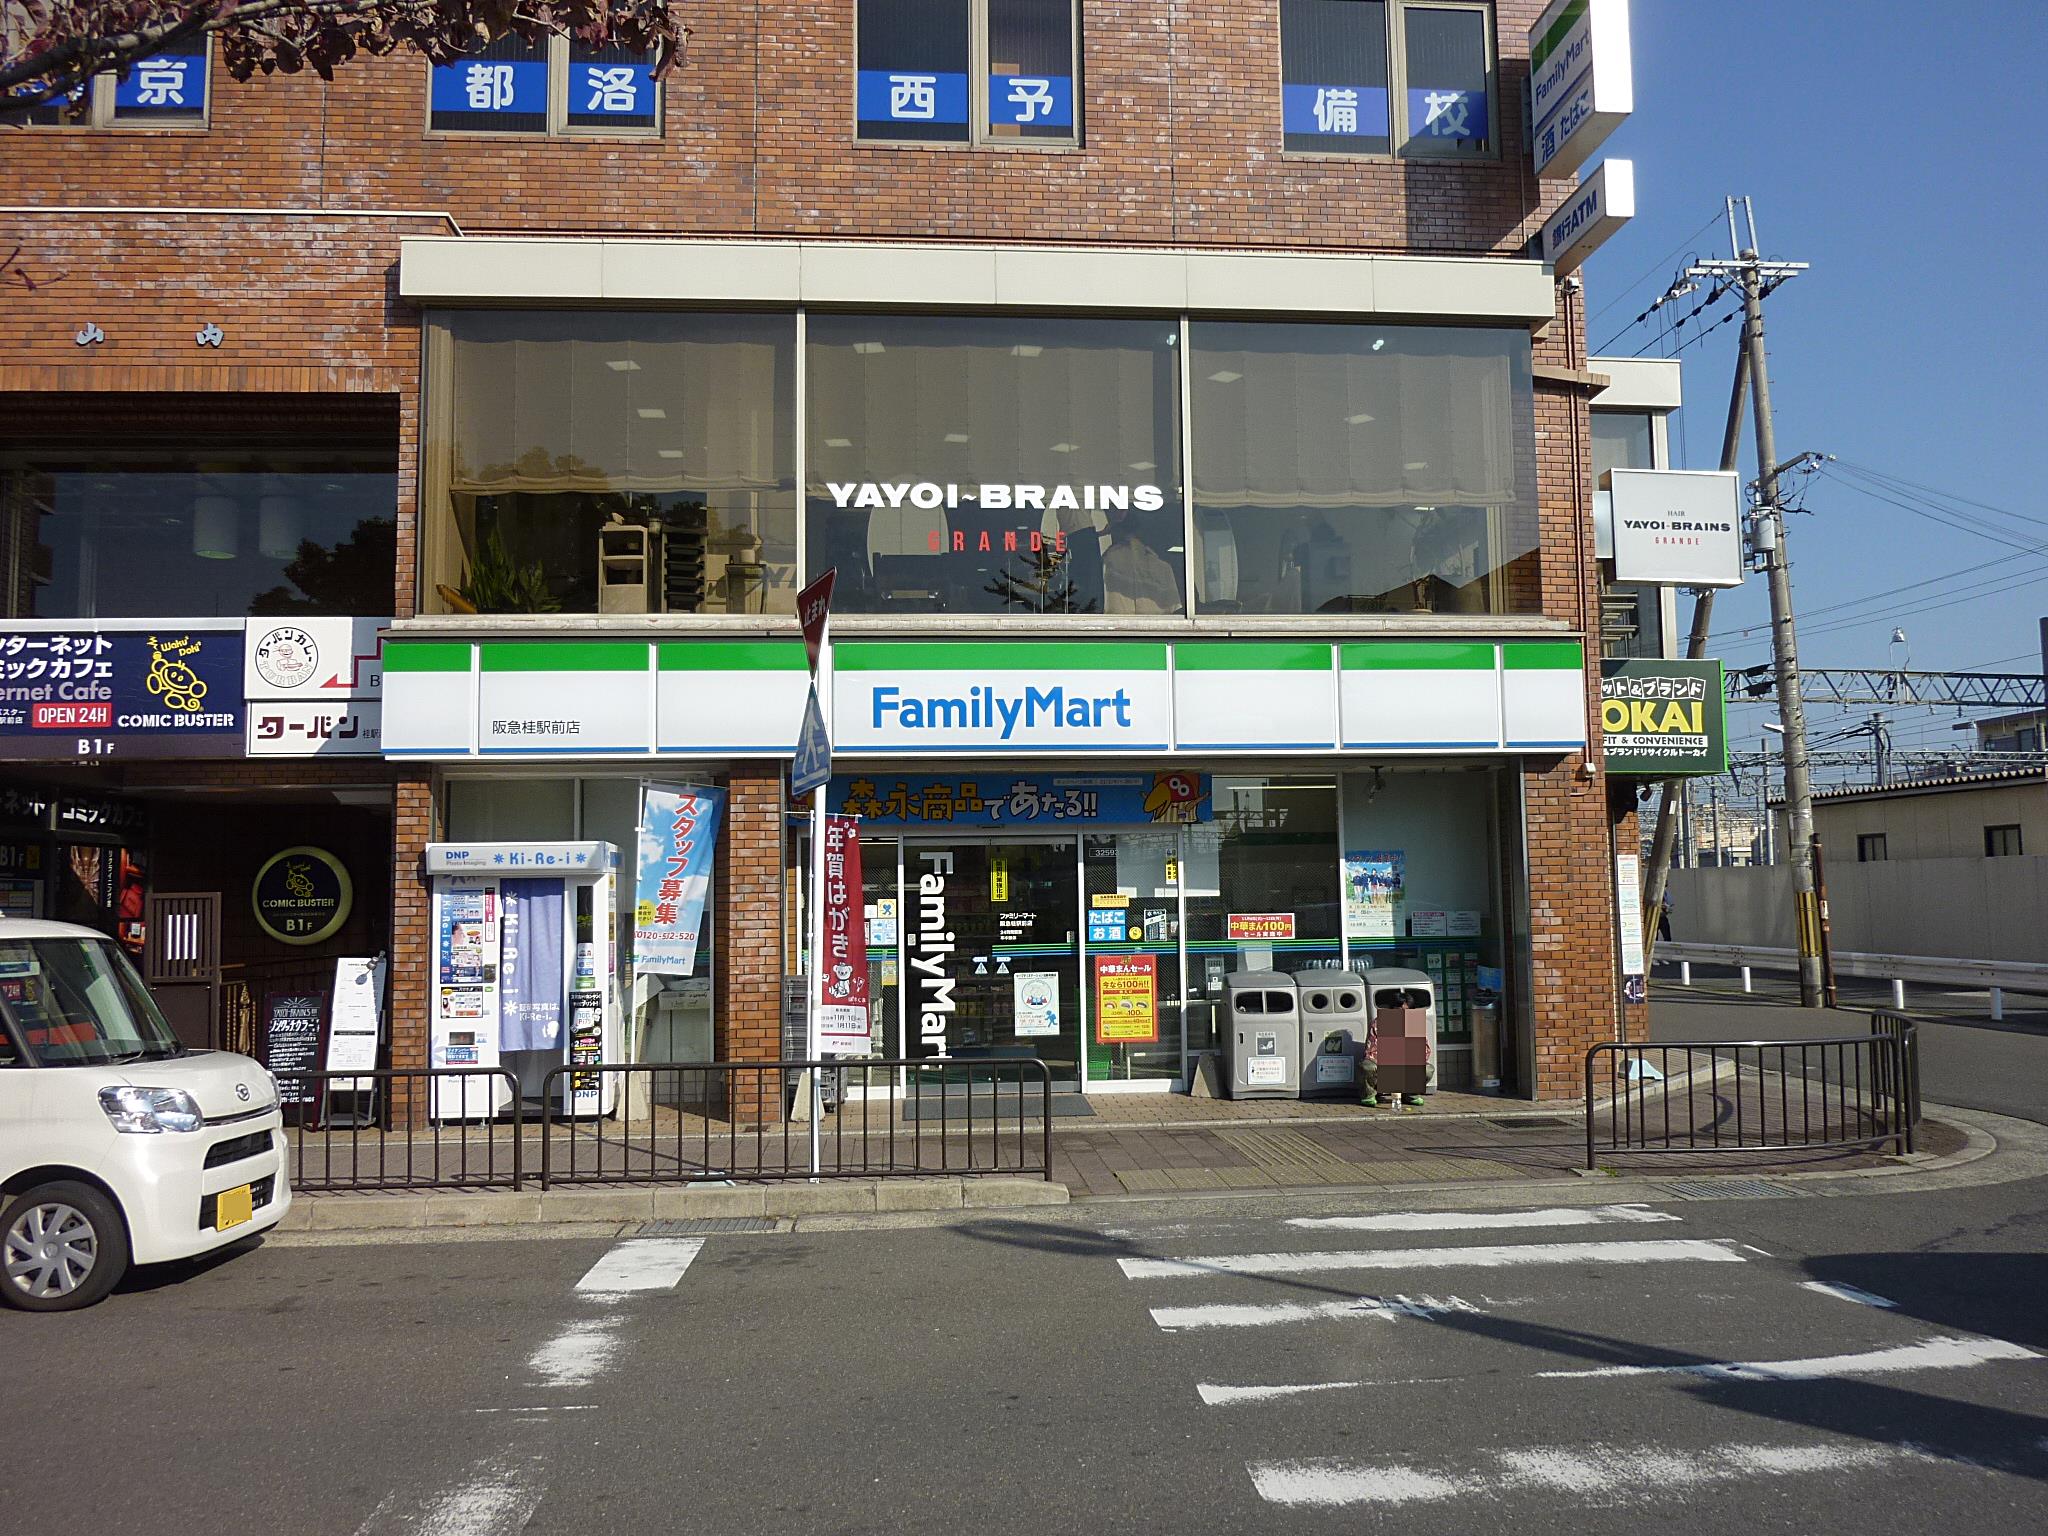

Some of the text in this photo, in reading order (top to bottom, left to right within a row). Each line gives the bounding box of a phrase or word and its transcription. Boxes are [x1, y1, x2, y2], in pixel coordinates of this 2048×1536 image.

[1536, 28, 1590, 107] FamilyMart
[136, 59, 1471, 137] 京 都 洛 西 予 備 校
[1541, 89, 1590, 164] 酒 たばこ
[1552, 189, 1598, 250] 銀行ATM
[928, 530, 1068, 552] GRANDE
[1655, 537, 1701, 545] GRANDE
[804, 596, 827, 627] 止まれ
[160, 637, 189, 652] Waku
[178, 643, 201, 657] Doki
[258, 629, 314, 662] ターバンカレー
[260, 660, 313, 686] TURBAN
[58, 680, 112, 700] Cafe
[39, 707, 107, 723] OPEN 24H
[118, 713, 234, 727] COMIC BUSTER
[873, 686, 1131, 739] FamilyMart
[1601, 699, 1703, 733] OKAI
[257, 716, 359, 739] ターバン
[491, 719, 581, 735] 阪急桂駅前店
[1633, 736, 1704, 745] CONVENIENCE
[842, 778, 1098, 821] 森永商品であたる!!
[445, 851, 469, 860] DNP
[653, 793, 698, 924] スタッフ募集
[827, 825, 850, 958] 年賀はがき
[1090, 911, 1125, 924] たばこ
[1230, 921, 1292, 931] 中華まん100円
[1093, 927, 1121, 939] お酒
